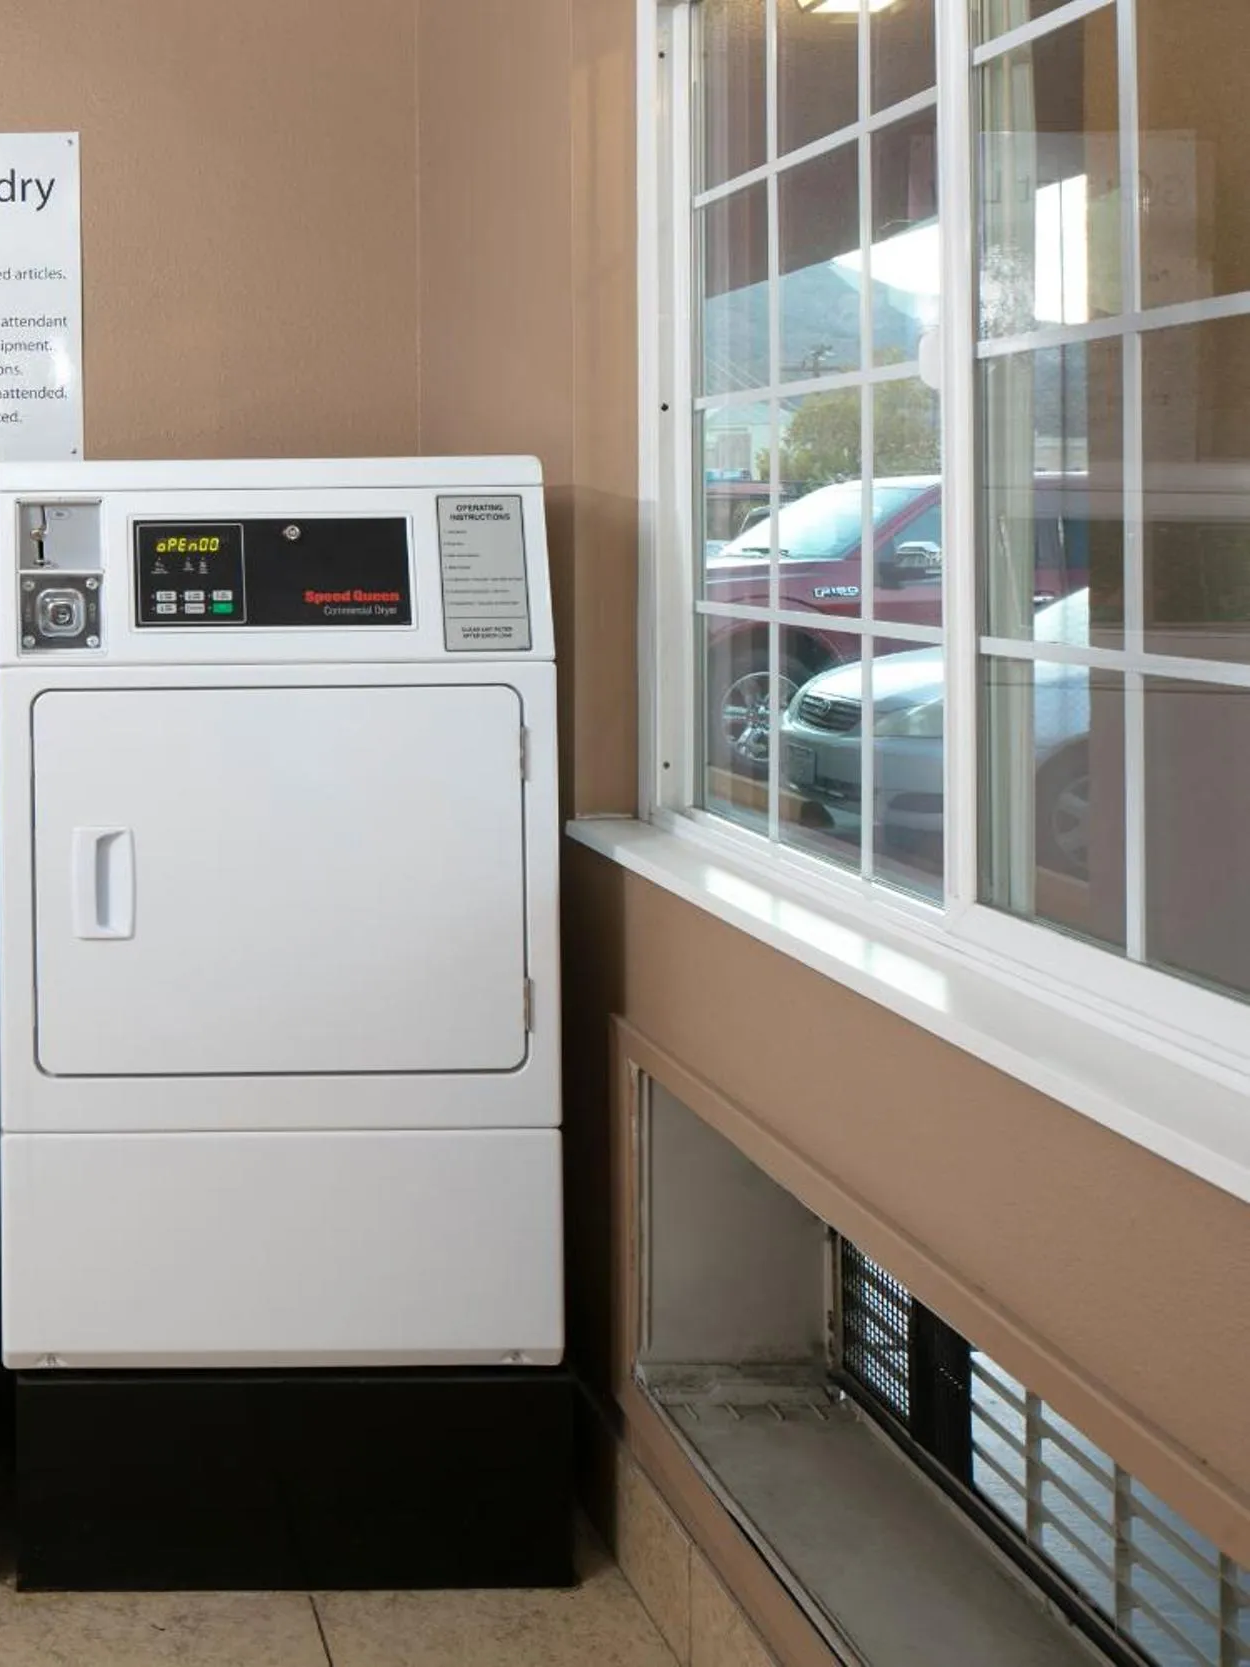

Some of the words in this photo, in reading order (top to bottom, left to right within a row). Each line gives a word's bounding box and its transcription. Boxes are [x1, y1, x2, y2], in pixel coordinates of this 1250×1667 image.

[14, 267, 67, 281] articles.
[1, 315, 68, 328] attendant
[456, 504, 504, 512] OPERATING
[305, 590, 351, 604] Speed
[353, 589, 400, 602] Queen
